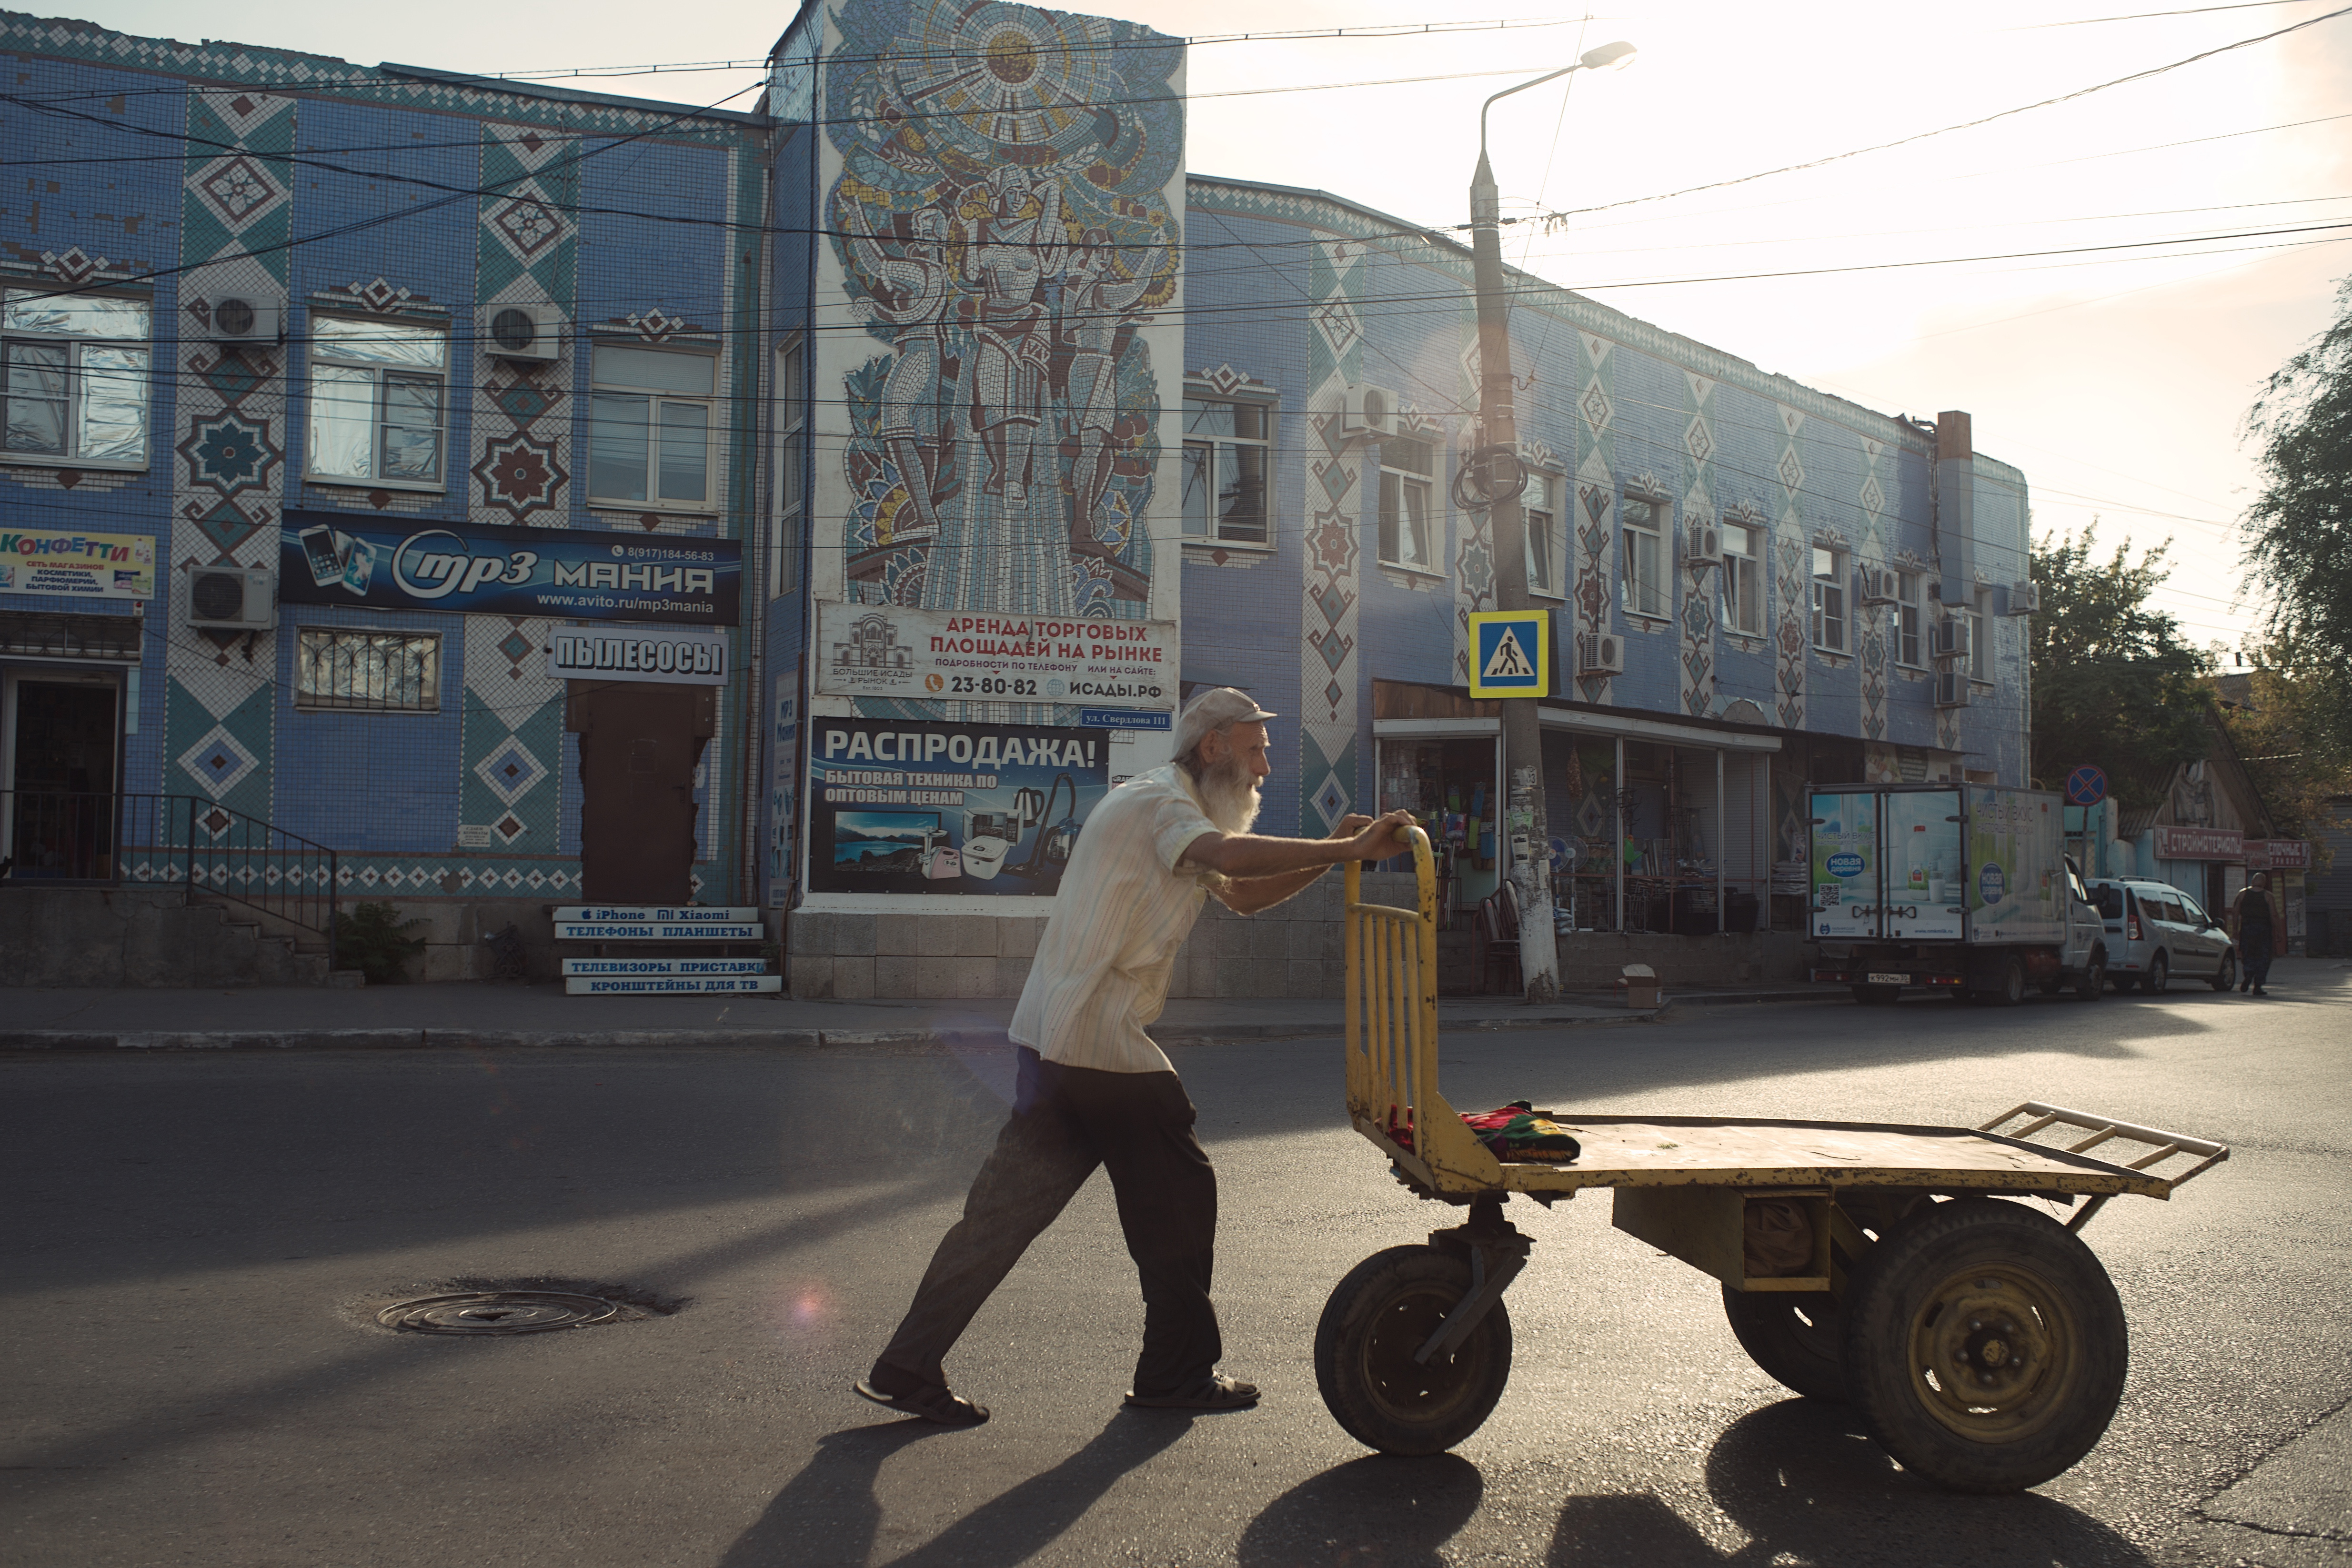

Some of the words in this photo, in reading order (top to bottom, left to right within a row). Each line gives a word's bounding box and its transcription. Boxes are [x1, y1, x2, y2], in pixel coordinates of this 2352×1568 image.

[627, 547, 714, 562] 8(917)184-56-83
[50, 562, 104, 570] МАГАЗИНОВ
[31, 576, 98, 585] ПАРФЮМЕРИИ,
[554, 559, 714, 594] МАНИЯ
[26, 583, 69, 592] БЫТОВОЙ
[537, 594, 714, 613] www.avito.ru/mp3mania
[946, 618, 1029, 636] АРЕНДА
[1035, 622, 1147, 642] ТОРГОВЫХ
[556, 636, 722, 675] ПЫЛЕСОСЫ
[931, 637, 1050, 657] ПЛОЩАДЕЙ
[1058, 643, 1086, 658] НА
[1092, 644, 1162, 662] РЫНКЕ
[834, 668, 878, 676] БОЛЬШИЕ
[935, 658, 1009, 668] ПОДРОБНОСТИ
[1028, 663, 1077, 672] ТЕЛЕФОНУ
[1125, 666, 1156, 675] САЙТЕ:
[951, 676, 1036, 695] 23-80-82
[1070, 682, 1161, 698] ИСАДЫ.РФ
[1086, 715, 1100, 724] ул.
[1102, 714, 1151, 726] Свердлова
[1153, 716, 1166, 725] 111
[825, 730, 1096, 770] РАСПРОДАЖА!
[826, 770, 904, 786] БЫТОВАЯ
[906, 772, 974, 788] ТЕХНИКА
[976, 775, 998, 789] ПО
[825, 788, 907, 804] ОПТОВЫМ
[909, 791, 964, 806] ЦЕНАМ
[1976, 801, 2010, 819] ЧИСТЫЙ
[2013, 805, 2033, 822] ВКУС
[1816, 831, 1849, 839] ЧИСТЫЙ
[2171, 831, 2242, 854] СТРОЙМАТЕРИАЛЫ
[1830, 858, 1861, 866] новая
[1982, 873, 2003, 885] новая
[596, 910, 645, 919] iPhone
[679, 910, 730, 920] Xiaomi
[566, 926, 653, 936] ТЕЛЕФОНЫ
[663, 927, 753, 937] ПЛАНШЕТЫ
[572, 963, 672, 972] ТЕЛЕВИЗОРЫ
[680, 963, 764, 973] ПРИСТАВКИ
[591, 980, 701, 991] КРОНШТЕЙНЫ
[705, 981, 735, 991] ДЛЯ
[739, 981, 758, 989] ТВ
